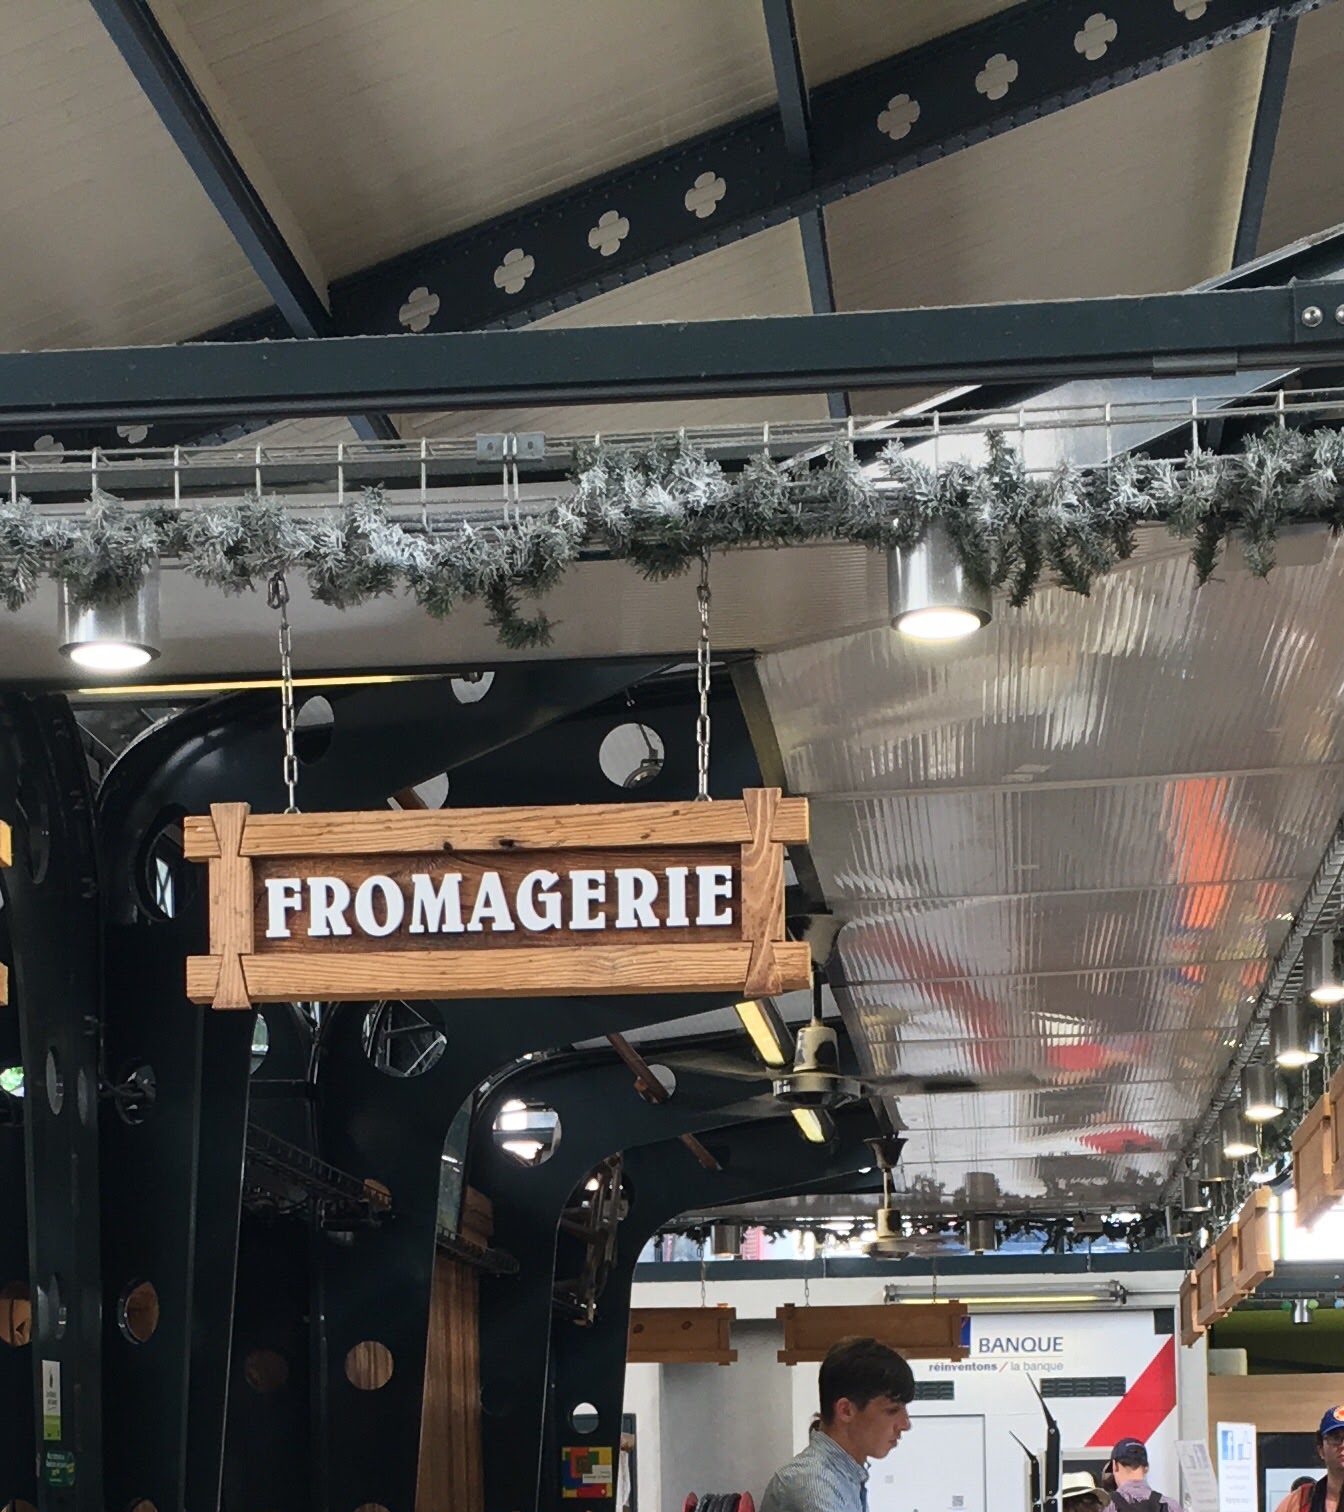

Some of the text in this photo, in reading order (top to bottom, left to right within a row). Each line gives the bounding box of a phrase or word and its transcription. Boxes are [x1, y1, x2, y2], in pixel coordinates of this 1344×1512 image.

[264, 864, 734, 939] FROMAGERIE
[979, 1336, 1063, 1353] BANQUE
[928, 1360, 1063, 1373] réinventons la banque
